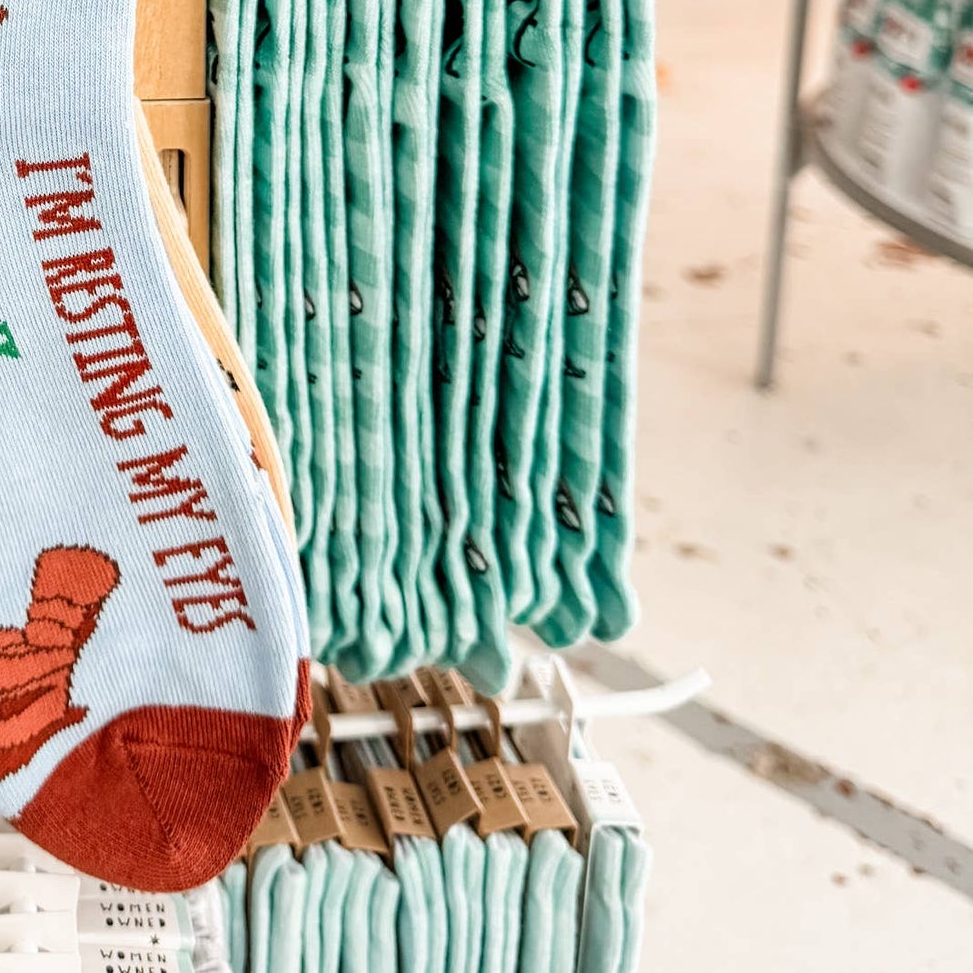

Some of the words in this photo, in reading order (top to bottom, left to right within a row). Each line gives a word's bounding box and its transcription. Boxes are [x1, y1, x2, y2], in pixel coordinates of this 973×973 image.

[15, 152, 102, 242] I'M
[41, 247, 174, 442] RESTING
[116, 444, 217, 525] MY
[152, 535, 257, 634] EYES
[100, 902, 165, 913] WOMEN
[106, 917, 165, 928] OWNED
[100, 949, 166, 963] WOMEN
